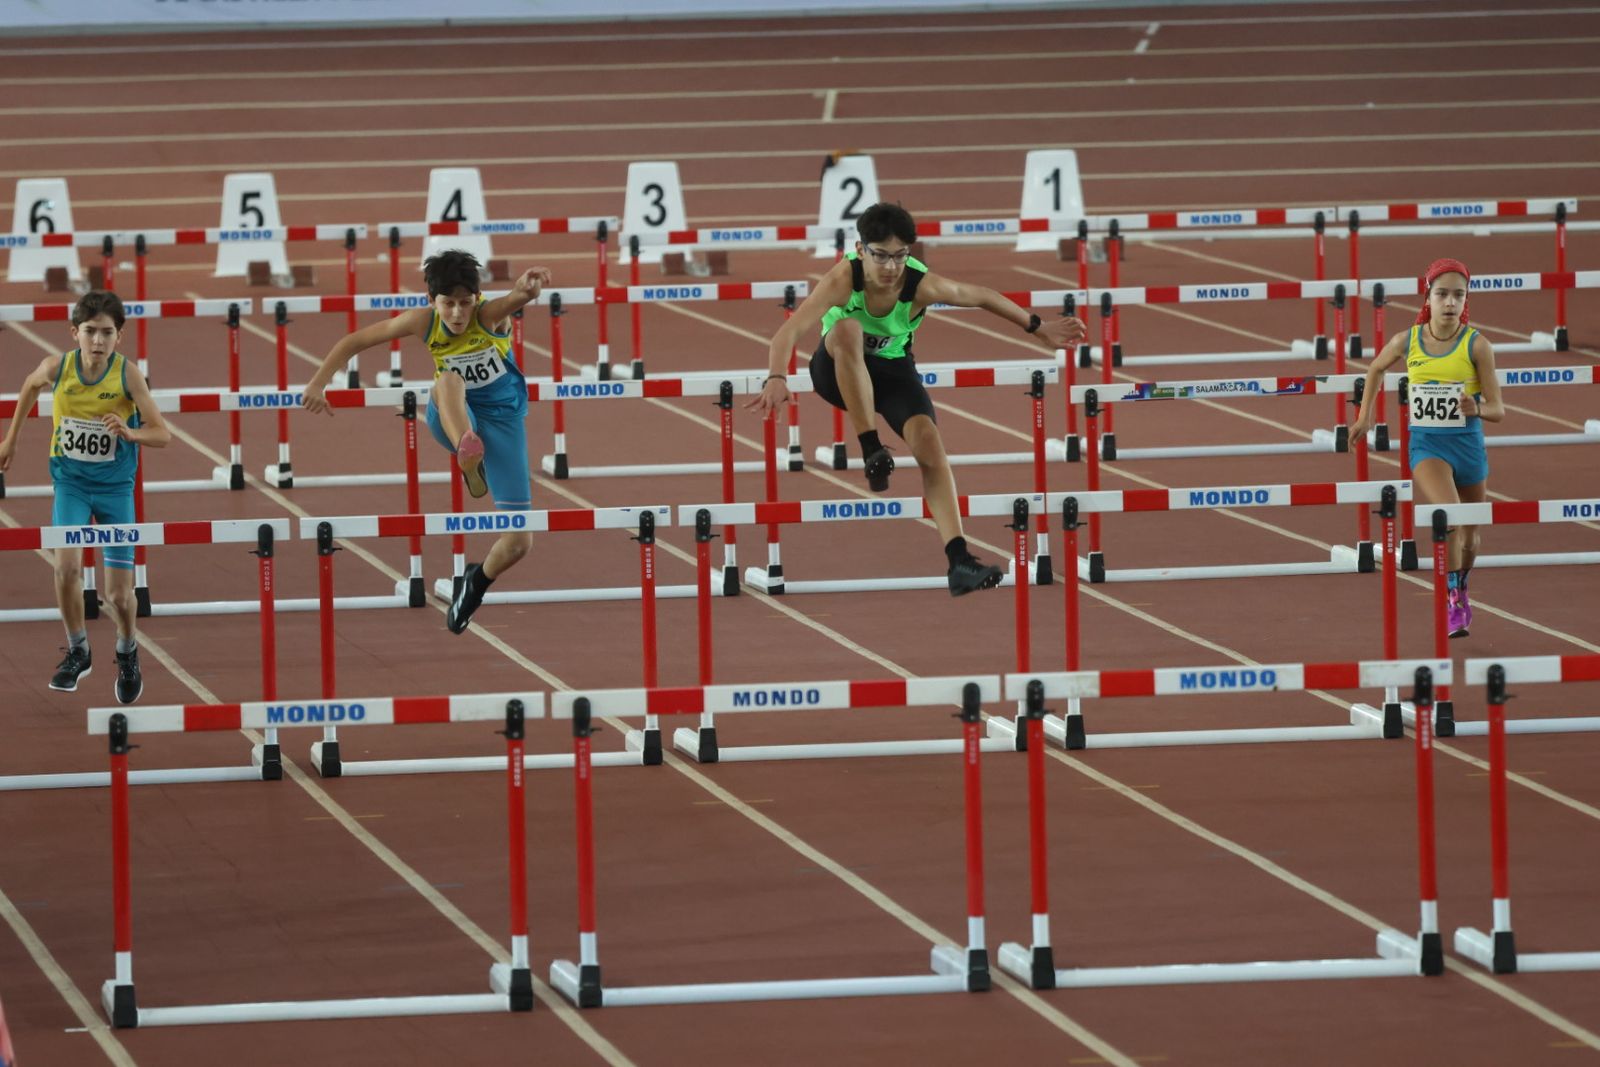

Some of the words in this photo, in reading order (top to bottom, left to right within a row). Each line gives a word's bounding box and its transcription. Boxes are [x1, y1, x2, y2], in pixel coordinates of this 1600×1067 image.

[1043, 167, 1061, 212] 1
[442, 188, 467, 221] 4
[642, 183, 668, 226] 3
[840, 177, 865, 220] 2
[30, 198, 56, 235] 6
[240, 191, 264, 229] 5
[1431, 205, 1483, 216] MONDO
[480, 222, 525, 233] MONDO
[954, 223, 1006, 233] MONDO
[1191, 214, 1242, 225] MONDO
[220, 230, 273, 241] MONDO
[712, 229, 763, 241] MONDO
[1470, 278, 1524, 289] MONDO
[371, 296, 428, 308] MONDO
[643, 287, 702, 300] MONDO
[1196, 288, 1249, 299] MONDO
[1506, 370, 1575, 386] MONDO
[556, 383, 624, 398] MONDO
[239, 393, 303, 408] MONDO
[1413, 397, 1460, 421] 3452
[64, 429, 112, 456] 3469
[1189, 489, 1271, 507] MONDO
[822, 501, 902, 518] MONDO
[446, 514, 526, 532] MONDO
[1180, 669, 1276, 690] MONDO
[733, 689, 820, 708] MONDO
[266, 703, 366, 724] MONDO
